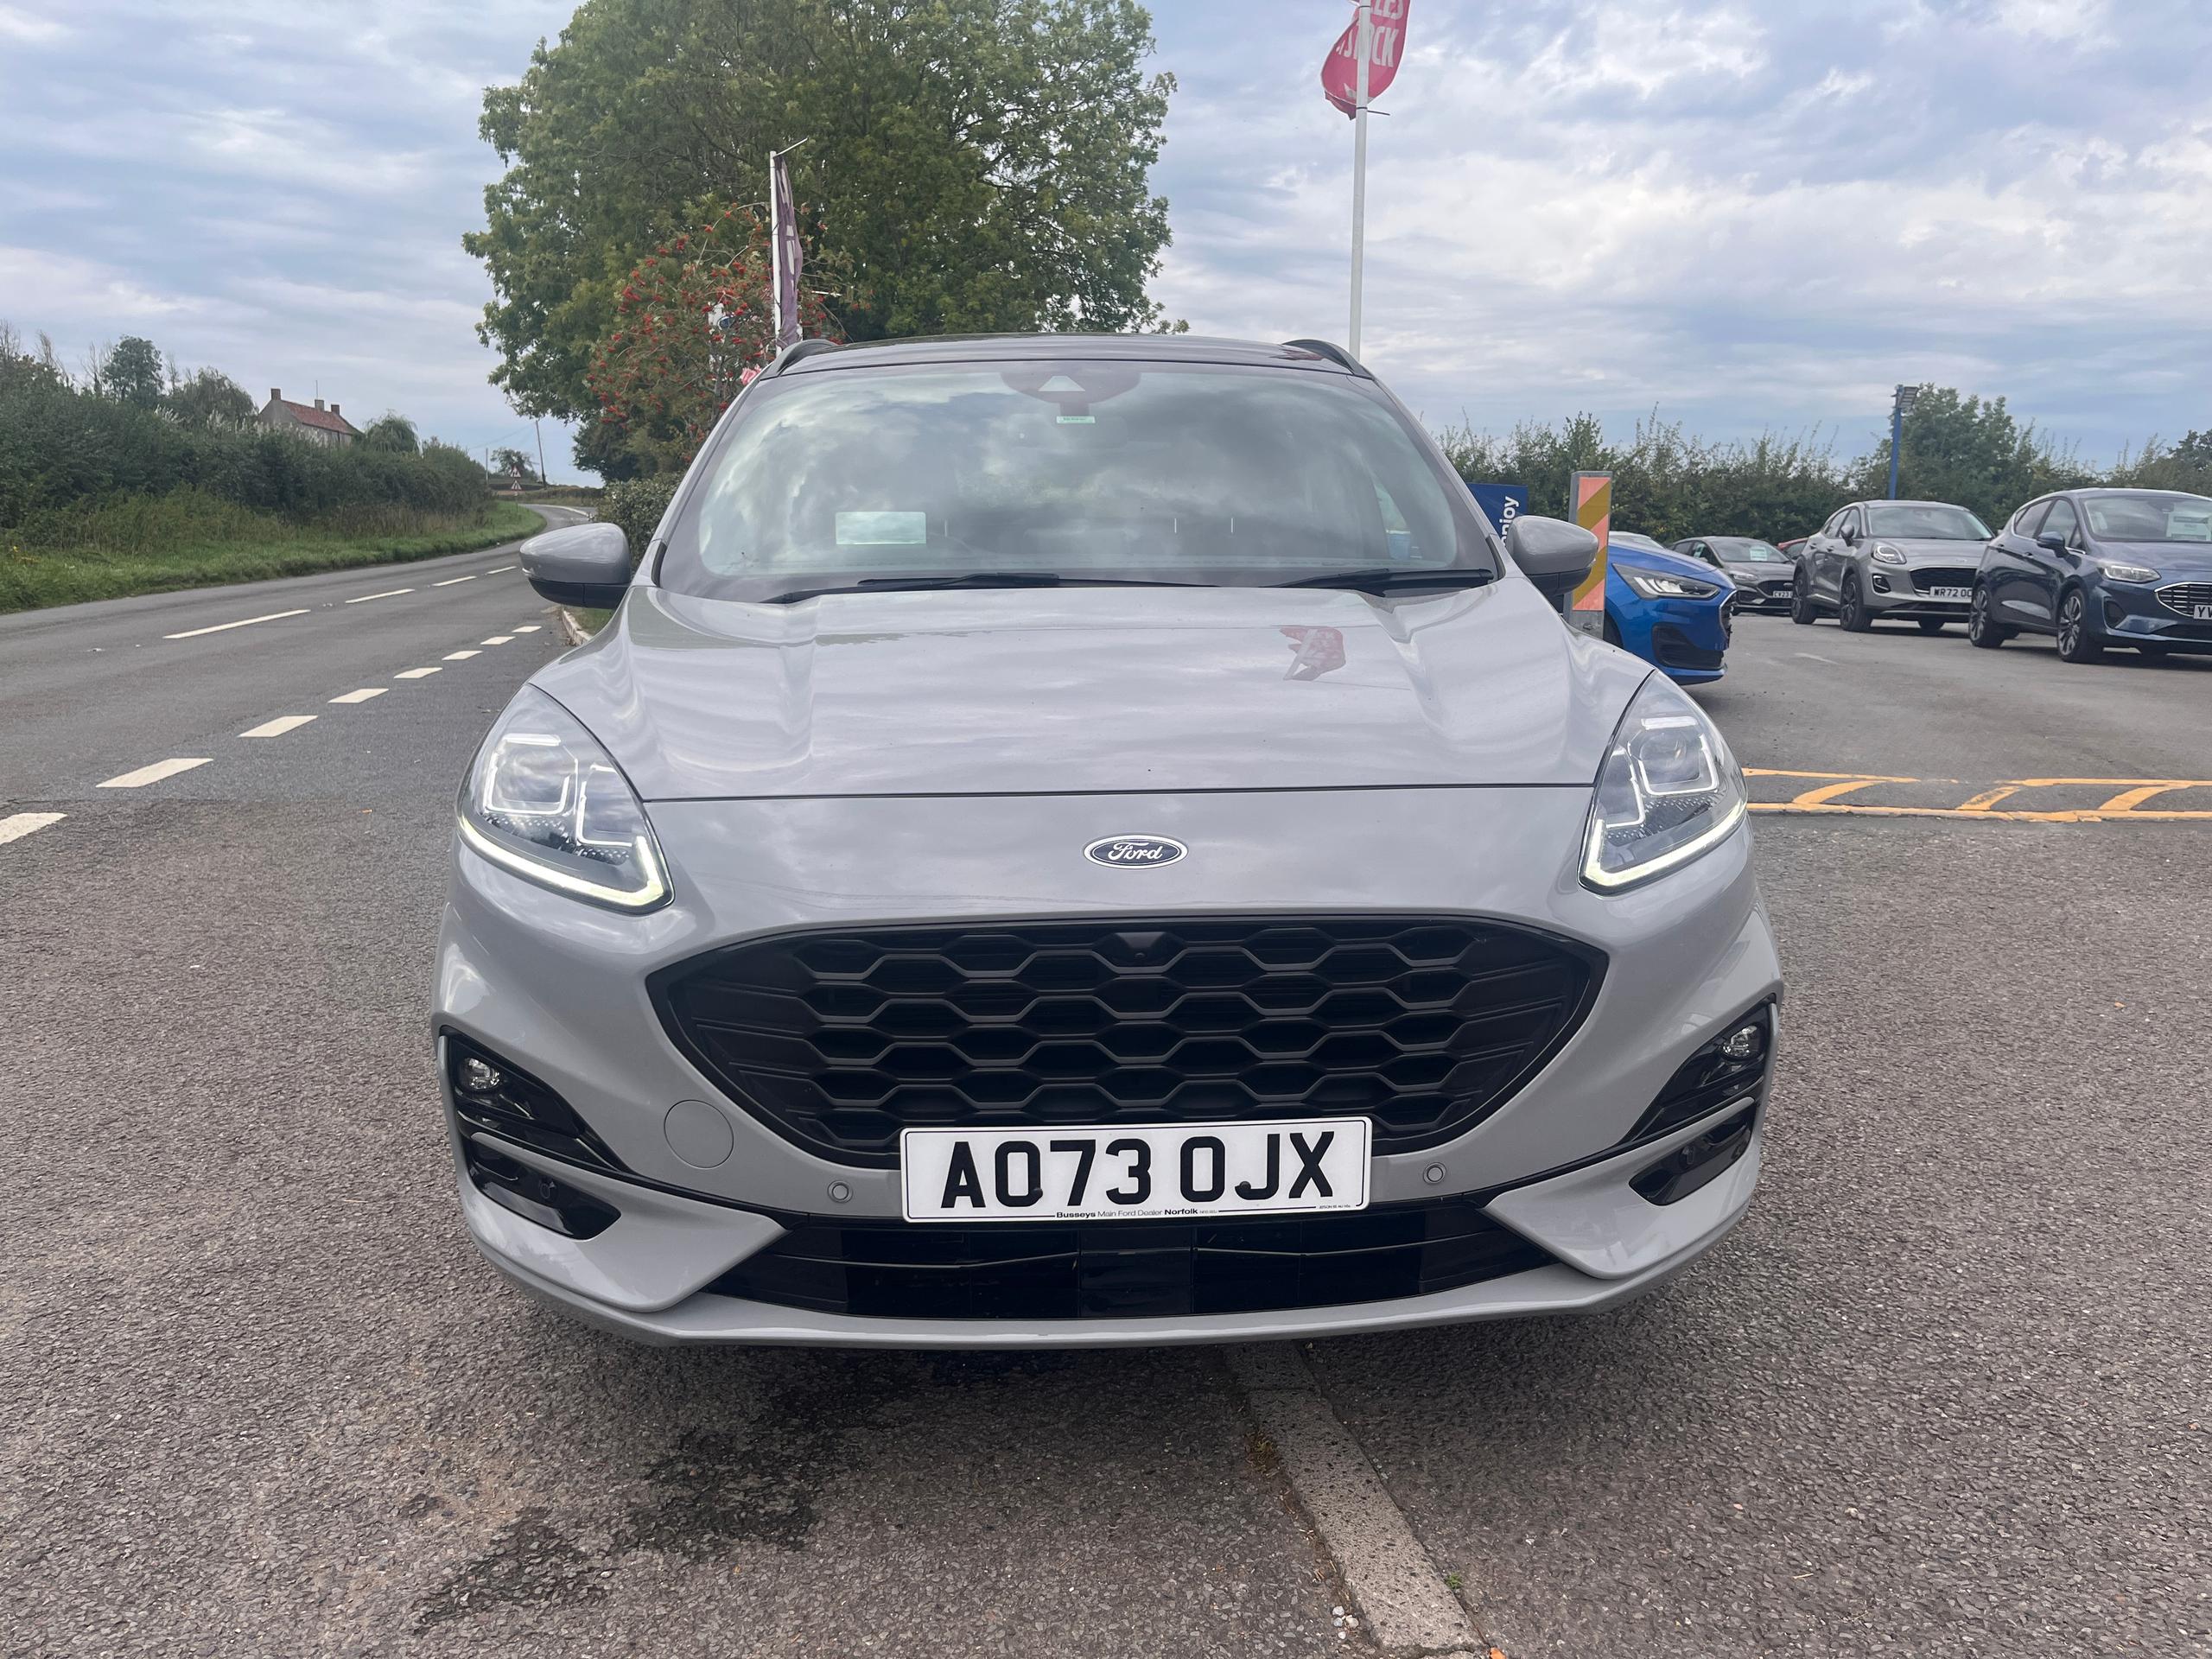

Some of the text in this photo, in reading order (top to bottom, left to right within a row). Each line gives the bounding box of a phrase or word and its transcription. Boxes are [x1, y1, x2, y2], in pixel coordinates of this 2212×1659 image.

[1934, 588, 1959, 598] WR72
[1108, 842, 1163, 861] Ford
[940, 1130, 1335, 1209] AO73 OJX
